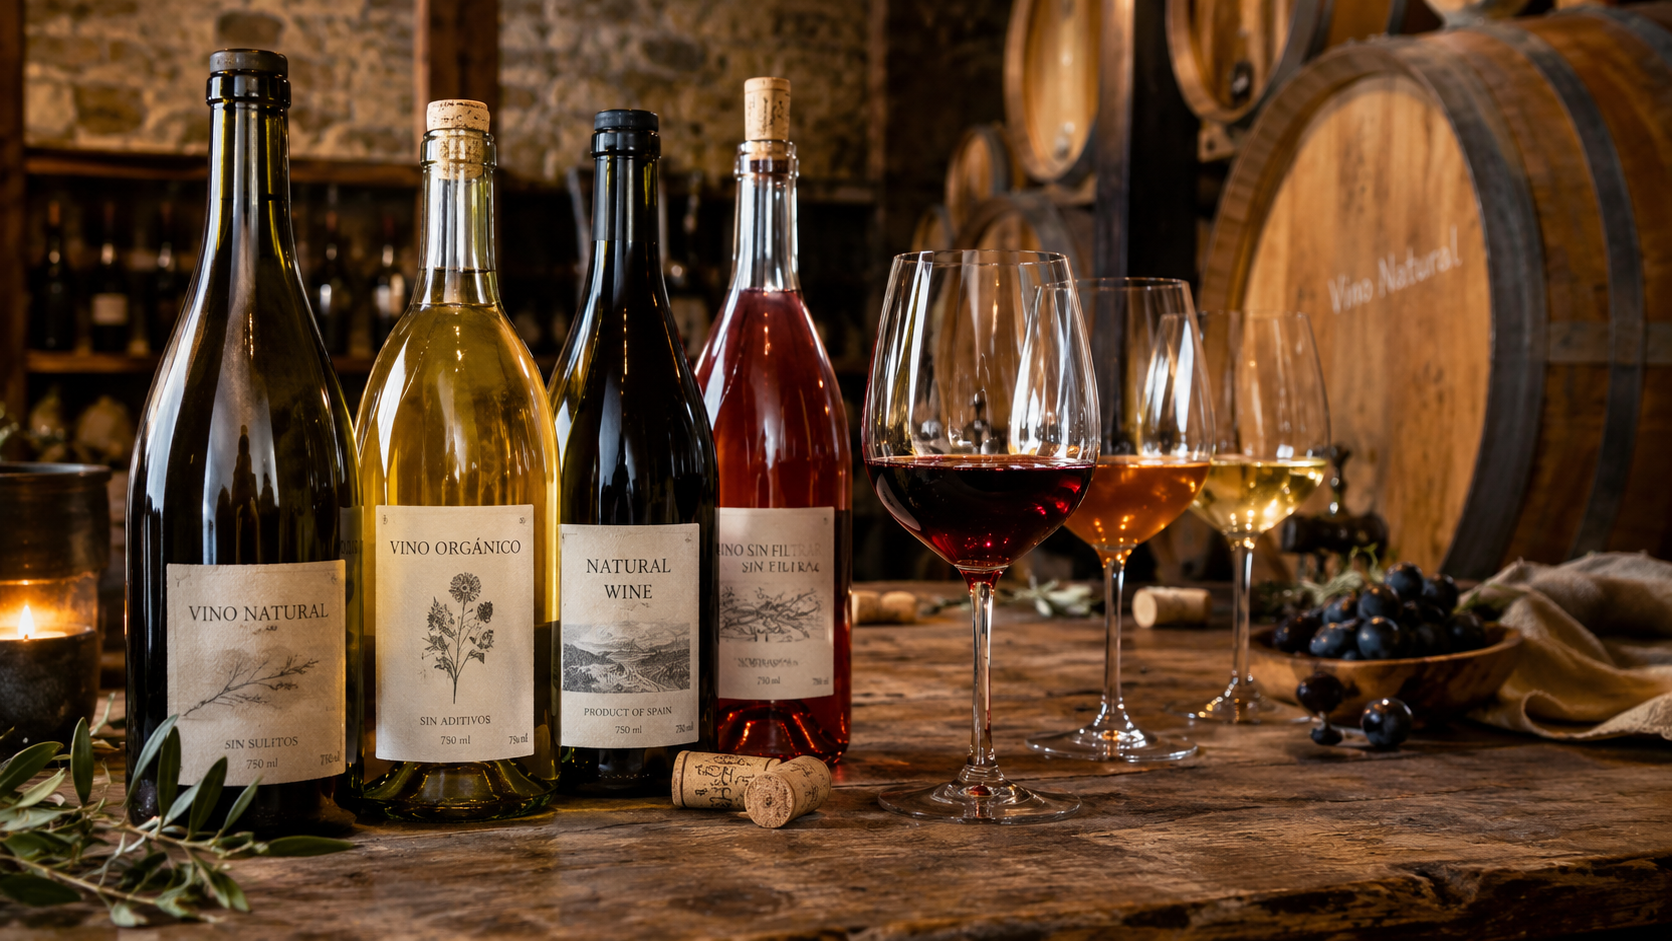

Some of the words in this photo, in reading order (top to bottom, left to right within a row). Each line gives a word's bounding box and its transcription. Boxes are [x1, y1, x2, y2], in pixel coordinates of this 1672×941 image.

[1327, 273, 1374, 315] Vino
[1377, 223, 1464, 299] Natural
[389, 540, 430, 555] VINO
[435, 537, 522, 555] ORGÁNICO
[747, 543, 769, 557] SIN
[586, 558, 672, 574] NATURAL
[742, 561, 764, 573] SIN
[604, 584, 653, 600] WINE
[188, 605, 238, 621] VINO
[243, 603, 329, 621] NATURAL
[584, 707, 630, 717] PRODUCT
[631, 708, 645, 717] OF
[646, 706, 672, 717] SPAIN
[420, 716, 438, 726] SIN
[440, 715, 491, 726] ADITIVOS
[632, 725, 642, 734] ml
[224, 739, 245, 750] SIN
[459, 735, 471, 745] ml
[266, 758, 278, 768] ml
